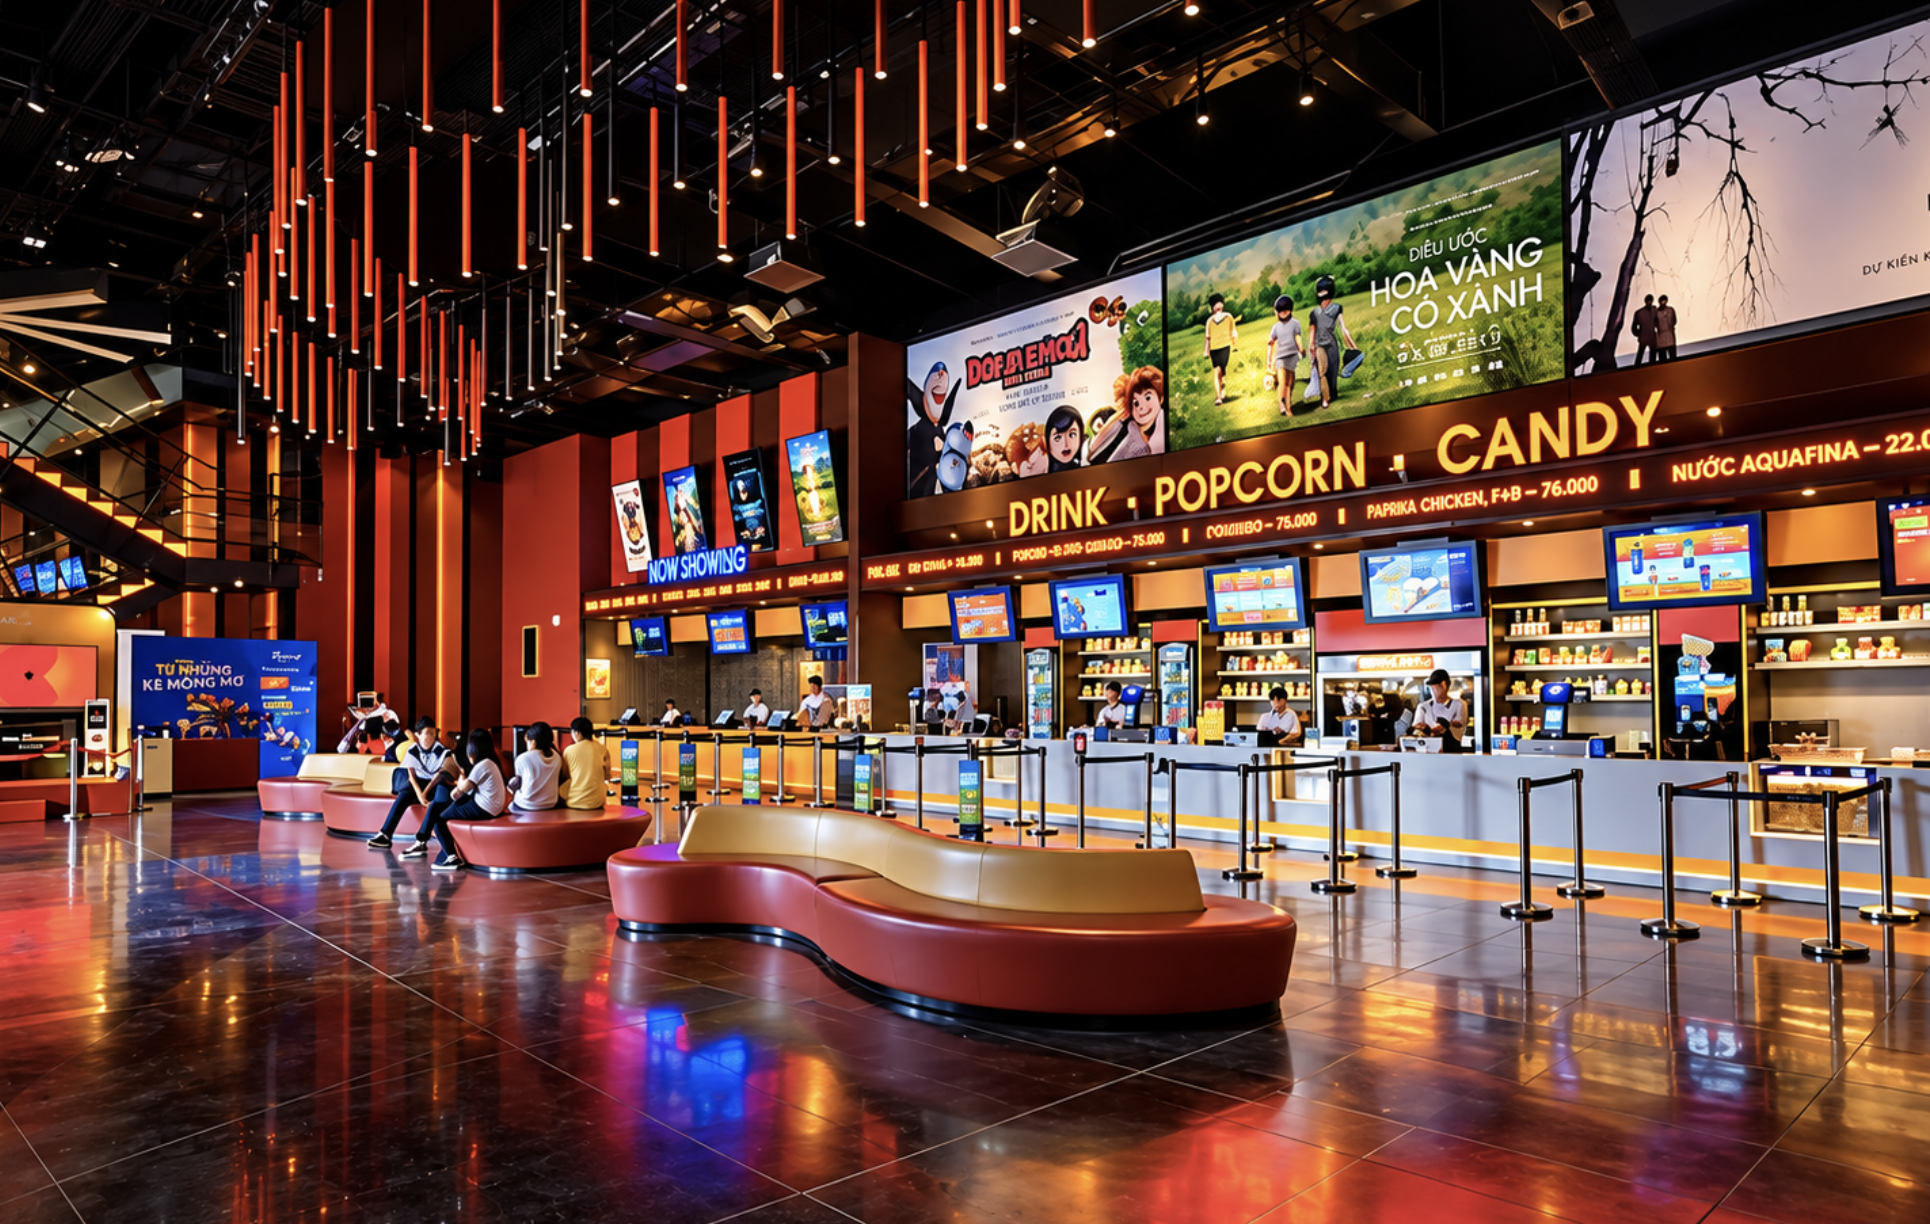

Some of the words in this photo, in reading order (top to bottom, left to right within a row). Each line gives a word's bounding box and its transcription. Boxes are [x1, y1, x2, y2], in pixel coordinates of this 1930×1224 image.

[1370, 265, 1439, 307] HOA
[1445, 236, 1544, 287] VÀNG
[1009, 486, 1109, 538] DRINK
[1154, 440, 1366, 517] POPCORN
[1437, 389, 1665, 475] CANDY
[1672, 454, 1737, 484] NƯỚC
[1739, 439, 1860, 475] AQUAFINA
[1366, 499, 1418, 520] PAPRIKA
[1420, 489, 1490, 512] CHICKEN,
[1541, 475, 1599, 499] 76.000
[1275, 511, 1318, 531] 75.000
[648, 555, 680, 584] NOW
